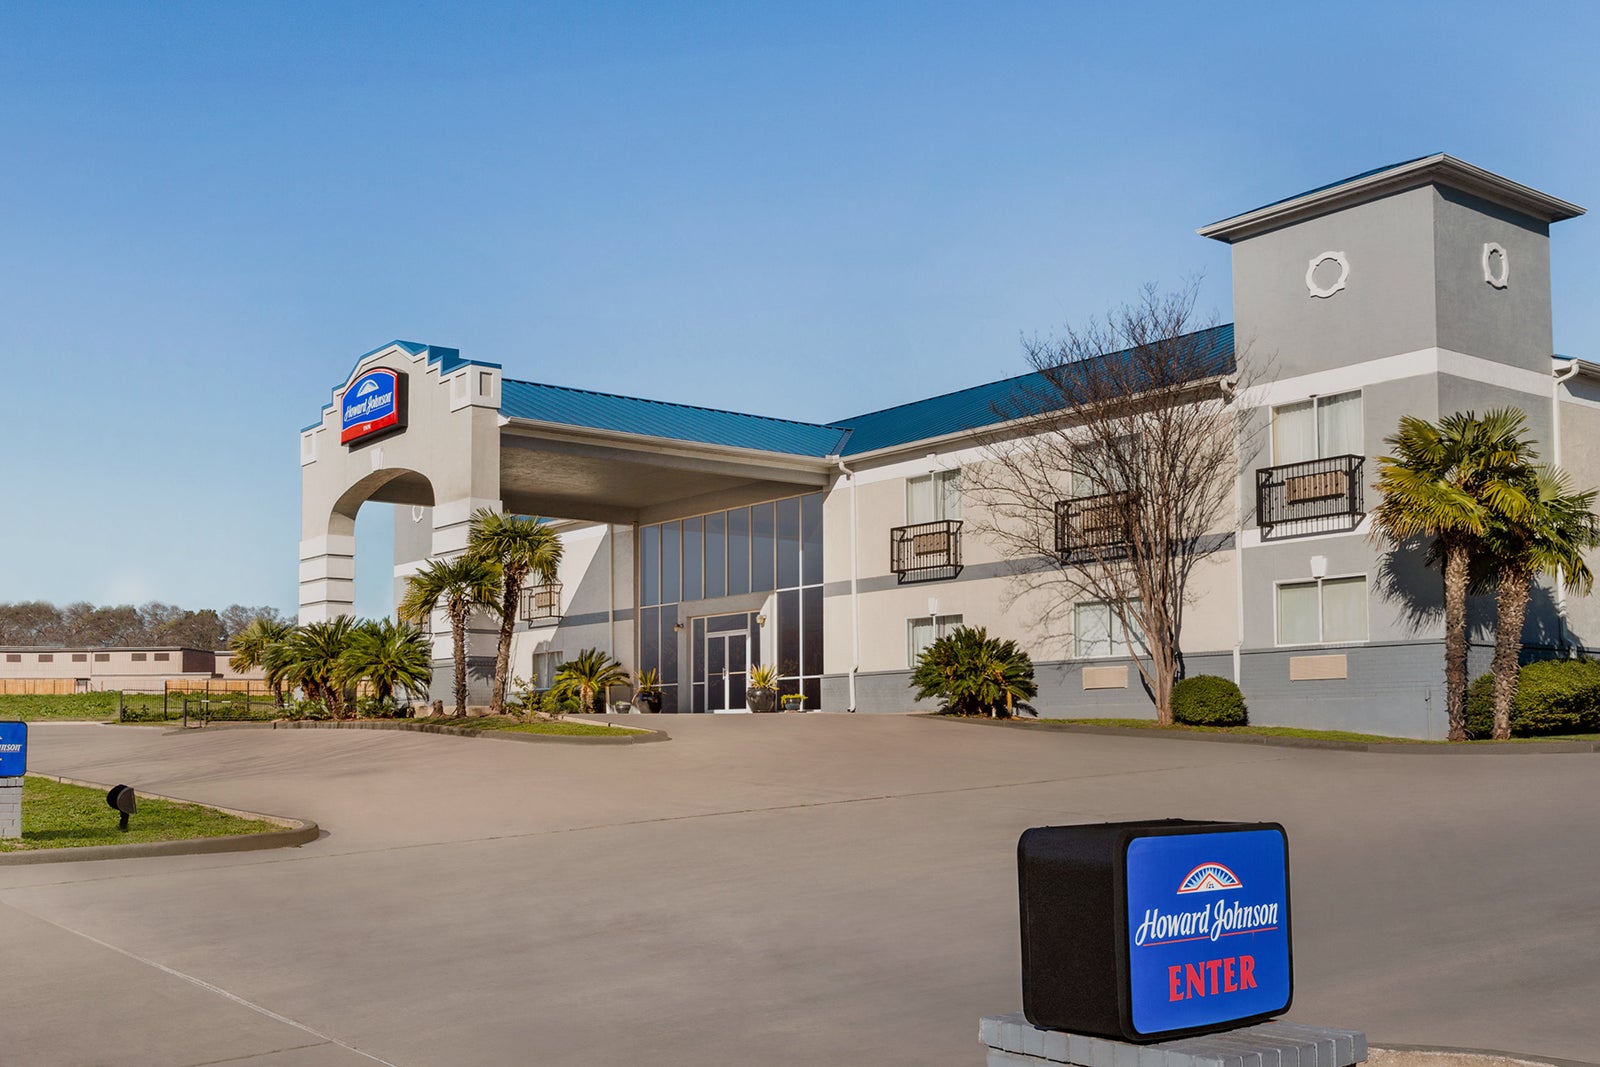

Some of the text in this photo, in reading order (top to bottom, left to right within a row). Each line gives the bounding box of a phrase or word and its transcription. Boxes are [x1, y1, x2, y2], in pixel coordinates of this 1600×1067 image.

[0, 743, 22, 752] nson
[1135, 899, 1278, 946] Howard Johnson
[1168, 955, 1257, 1002] ENTER
